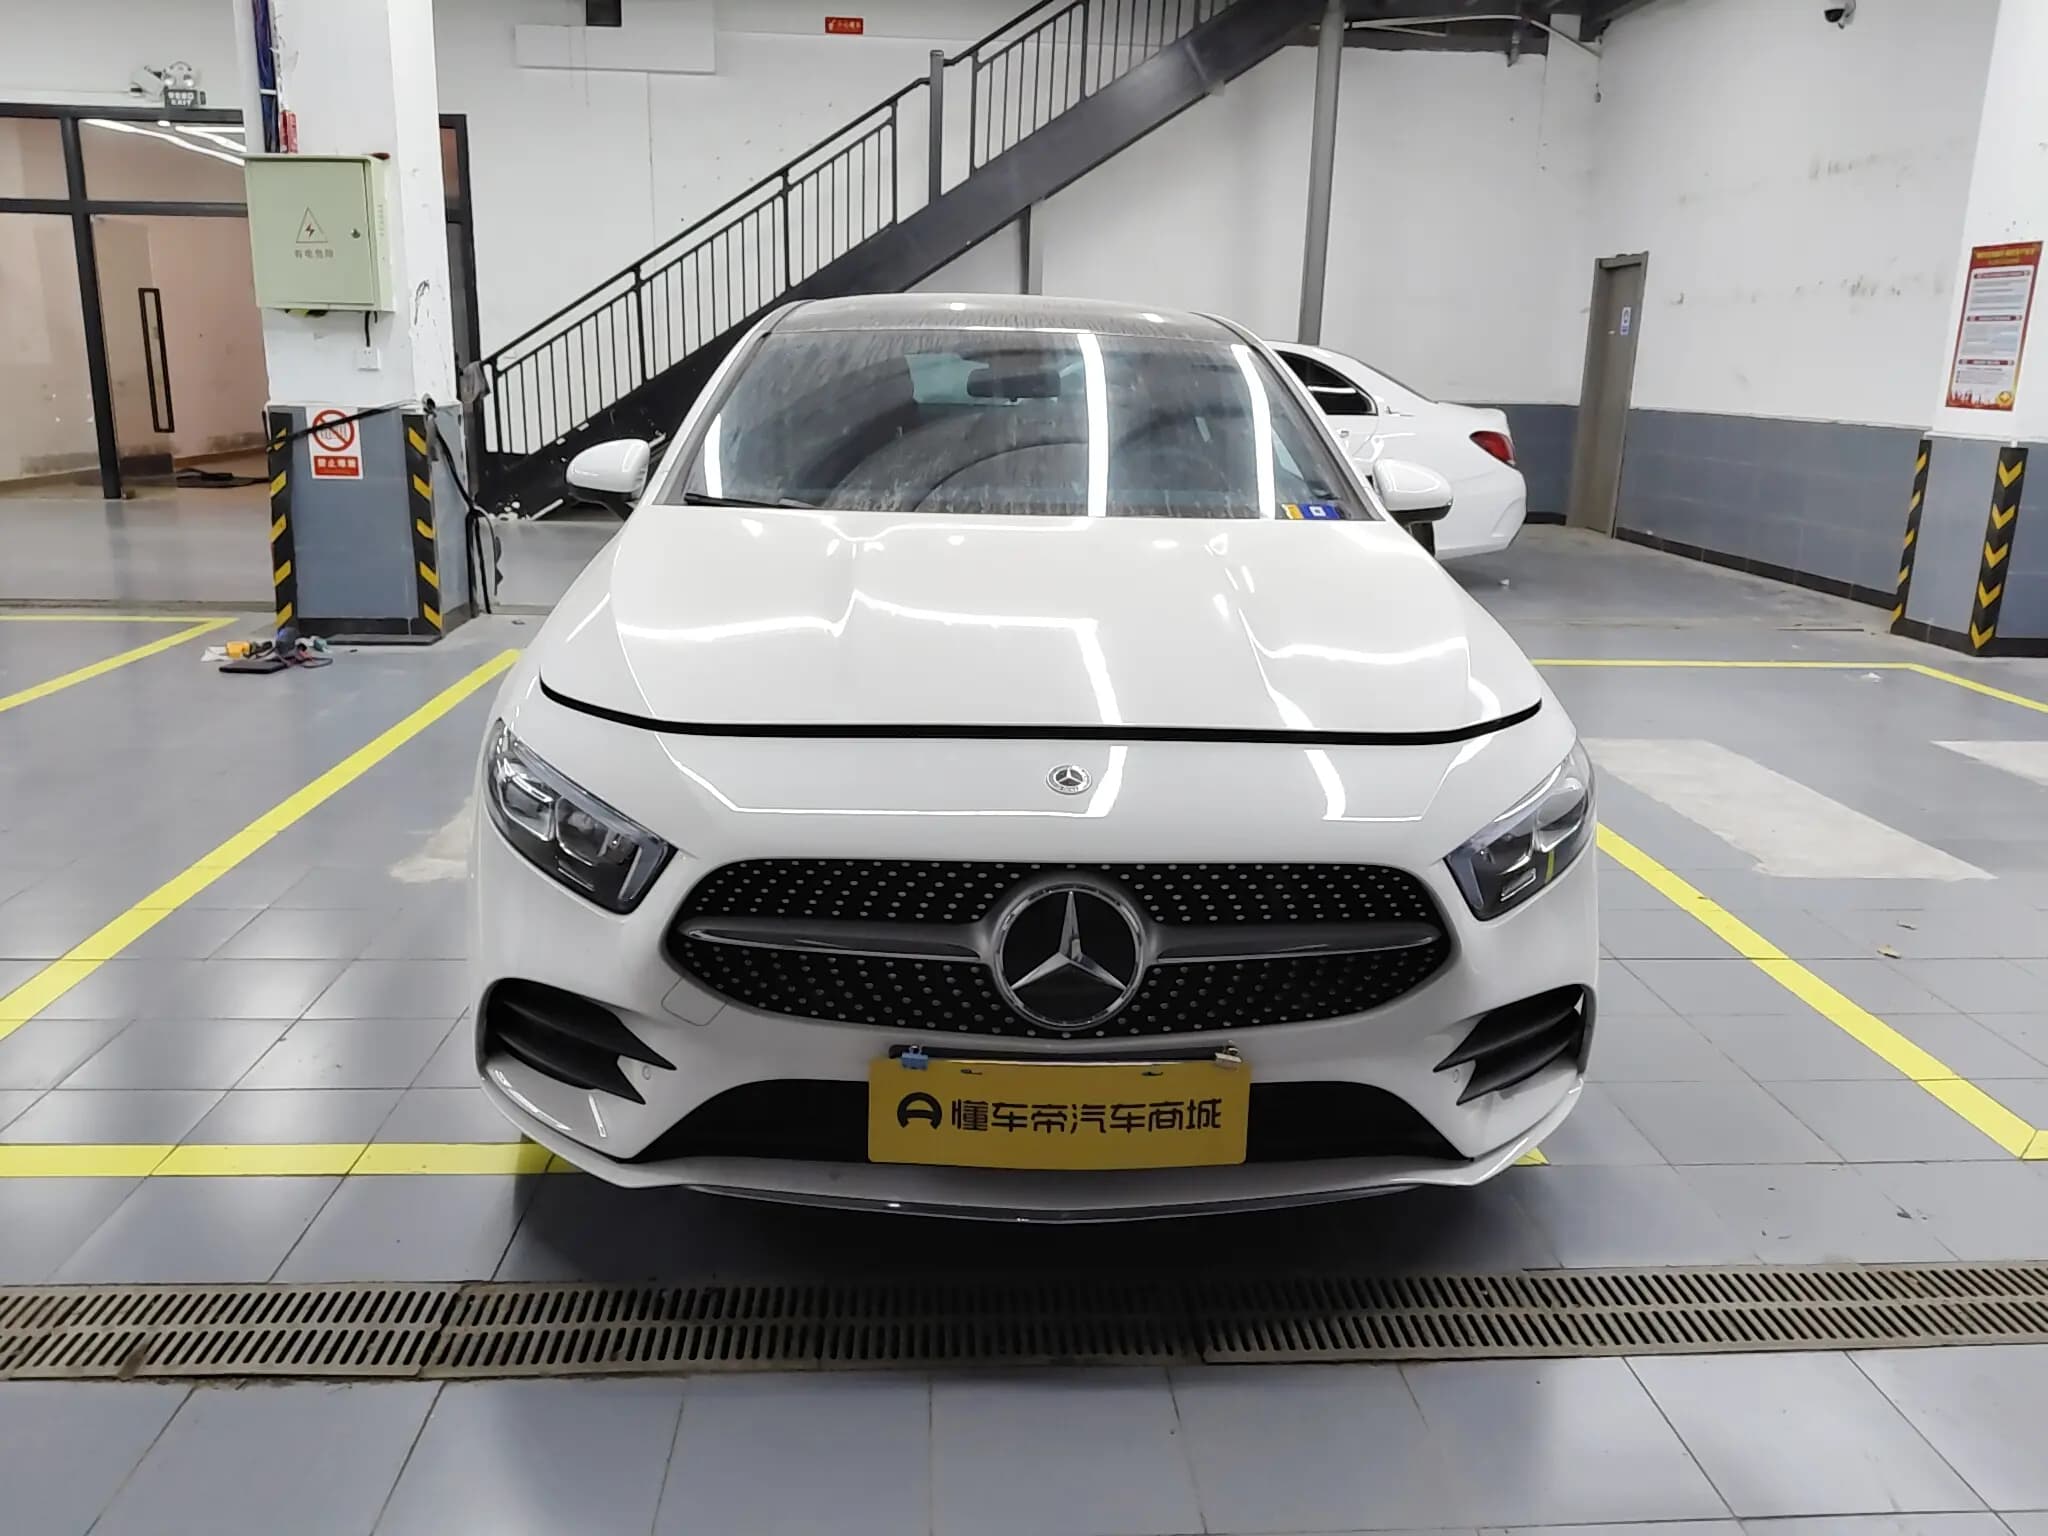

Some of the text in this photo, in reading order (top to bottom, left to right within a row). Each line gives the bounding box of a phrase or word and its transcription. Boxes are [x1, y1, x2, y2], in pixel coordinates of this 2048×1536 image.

[951, 1098, 1223, 1134] 懂车帝汽车商城
